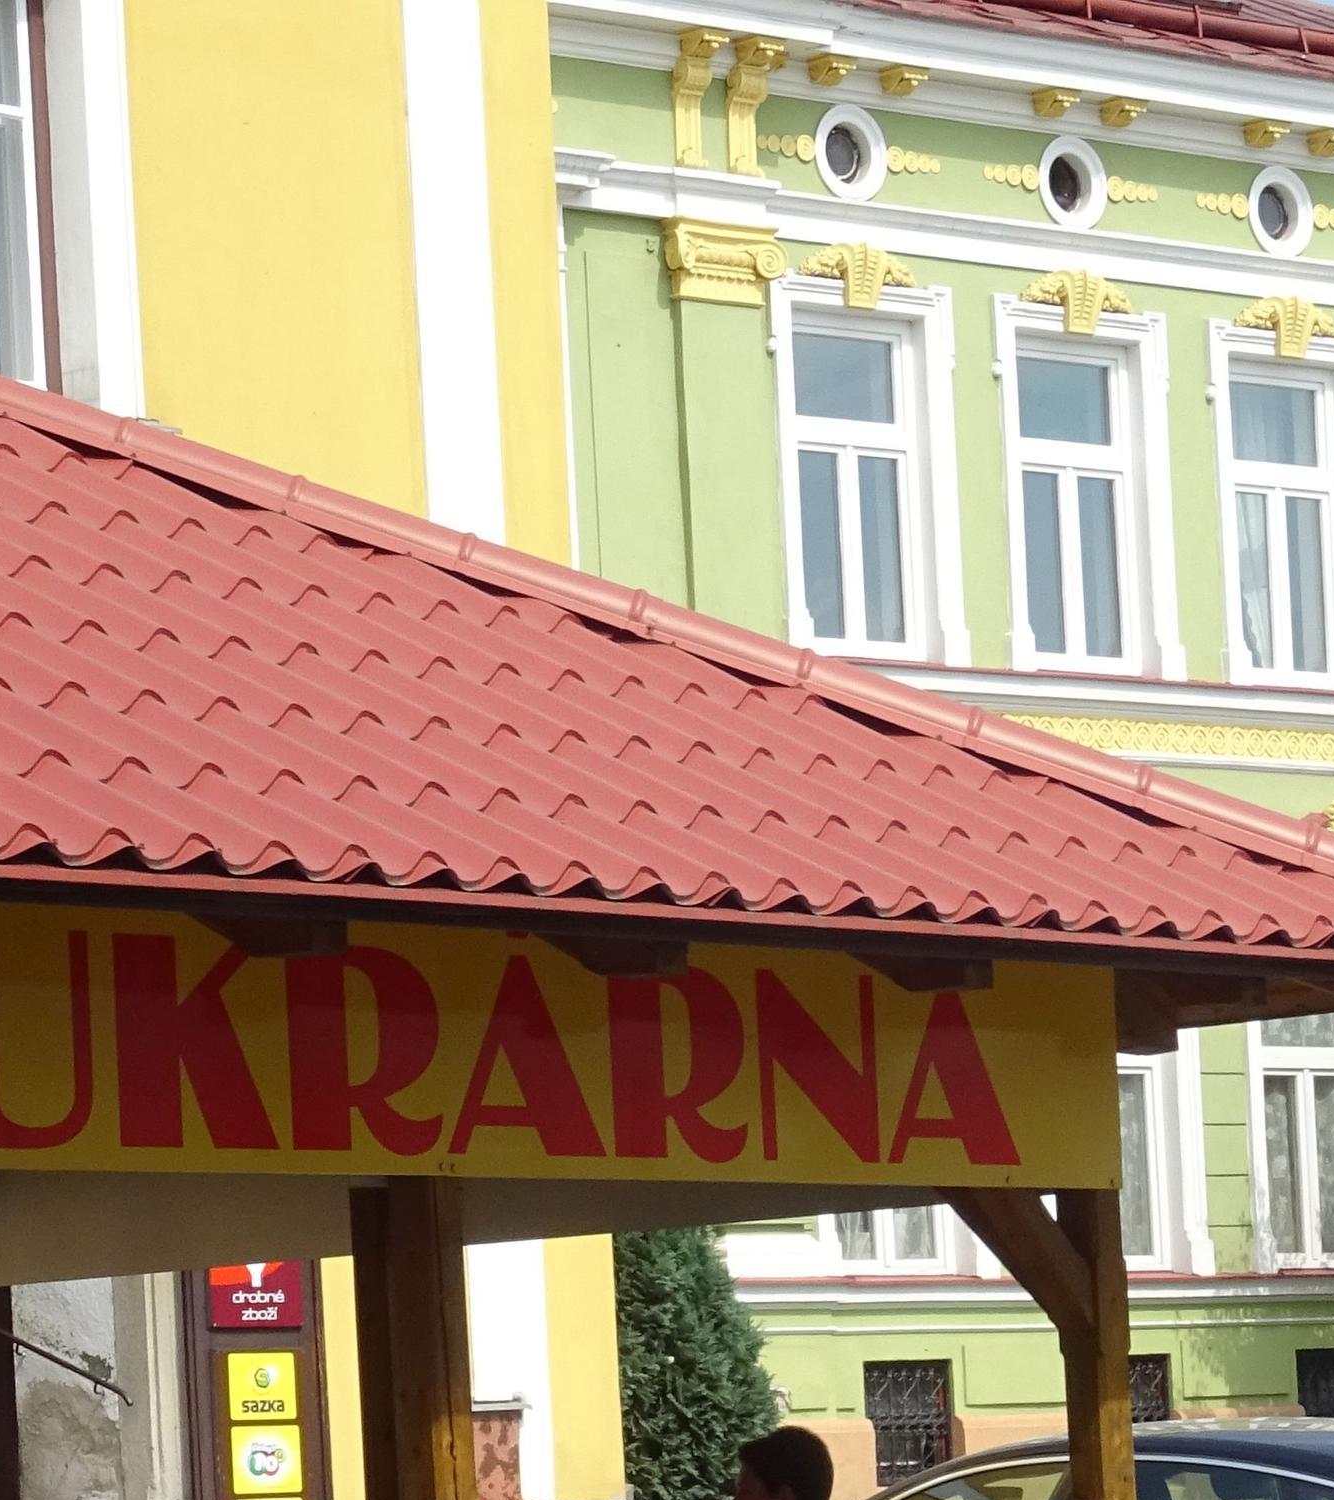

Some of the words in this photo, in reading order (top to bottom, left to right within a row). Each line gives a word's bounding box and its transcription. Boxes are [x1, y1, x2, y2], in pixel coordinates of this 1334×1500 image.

[232, 1289, 285, 1304] drobné
[241, 1307, 278, 1321] zboží
[241, 1400, 285, 1413] sazka
